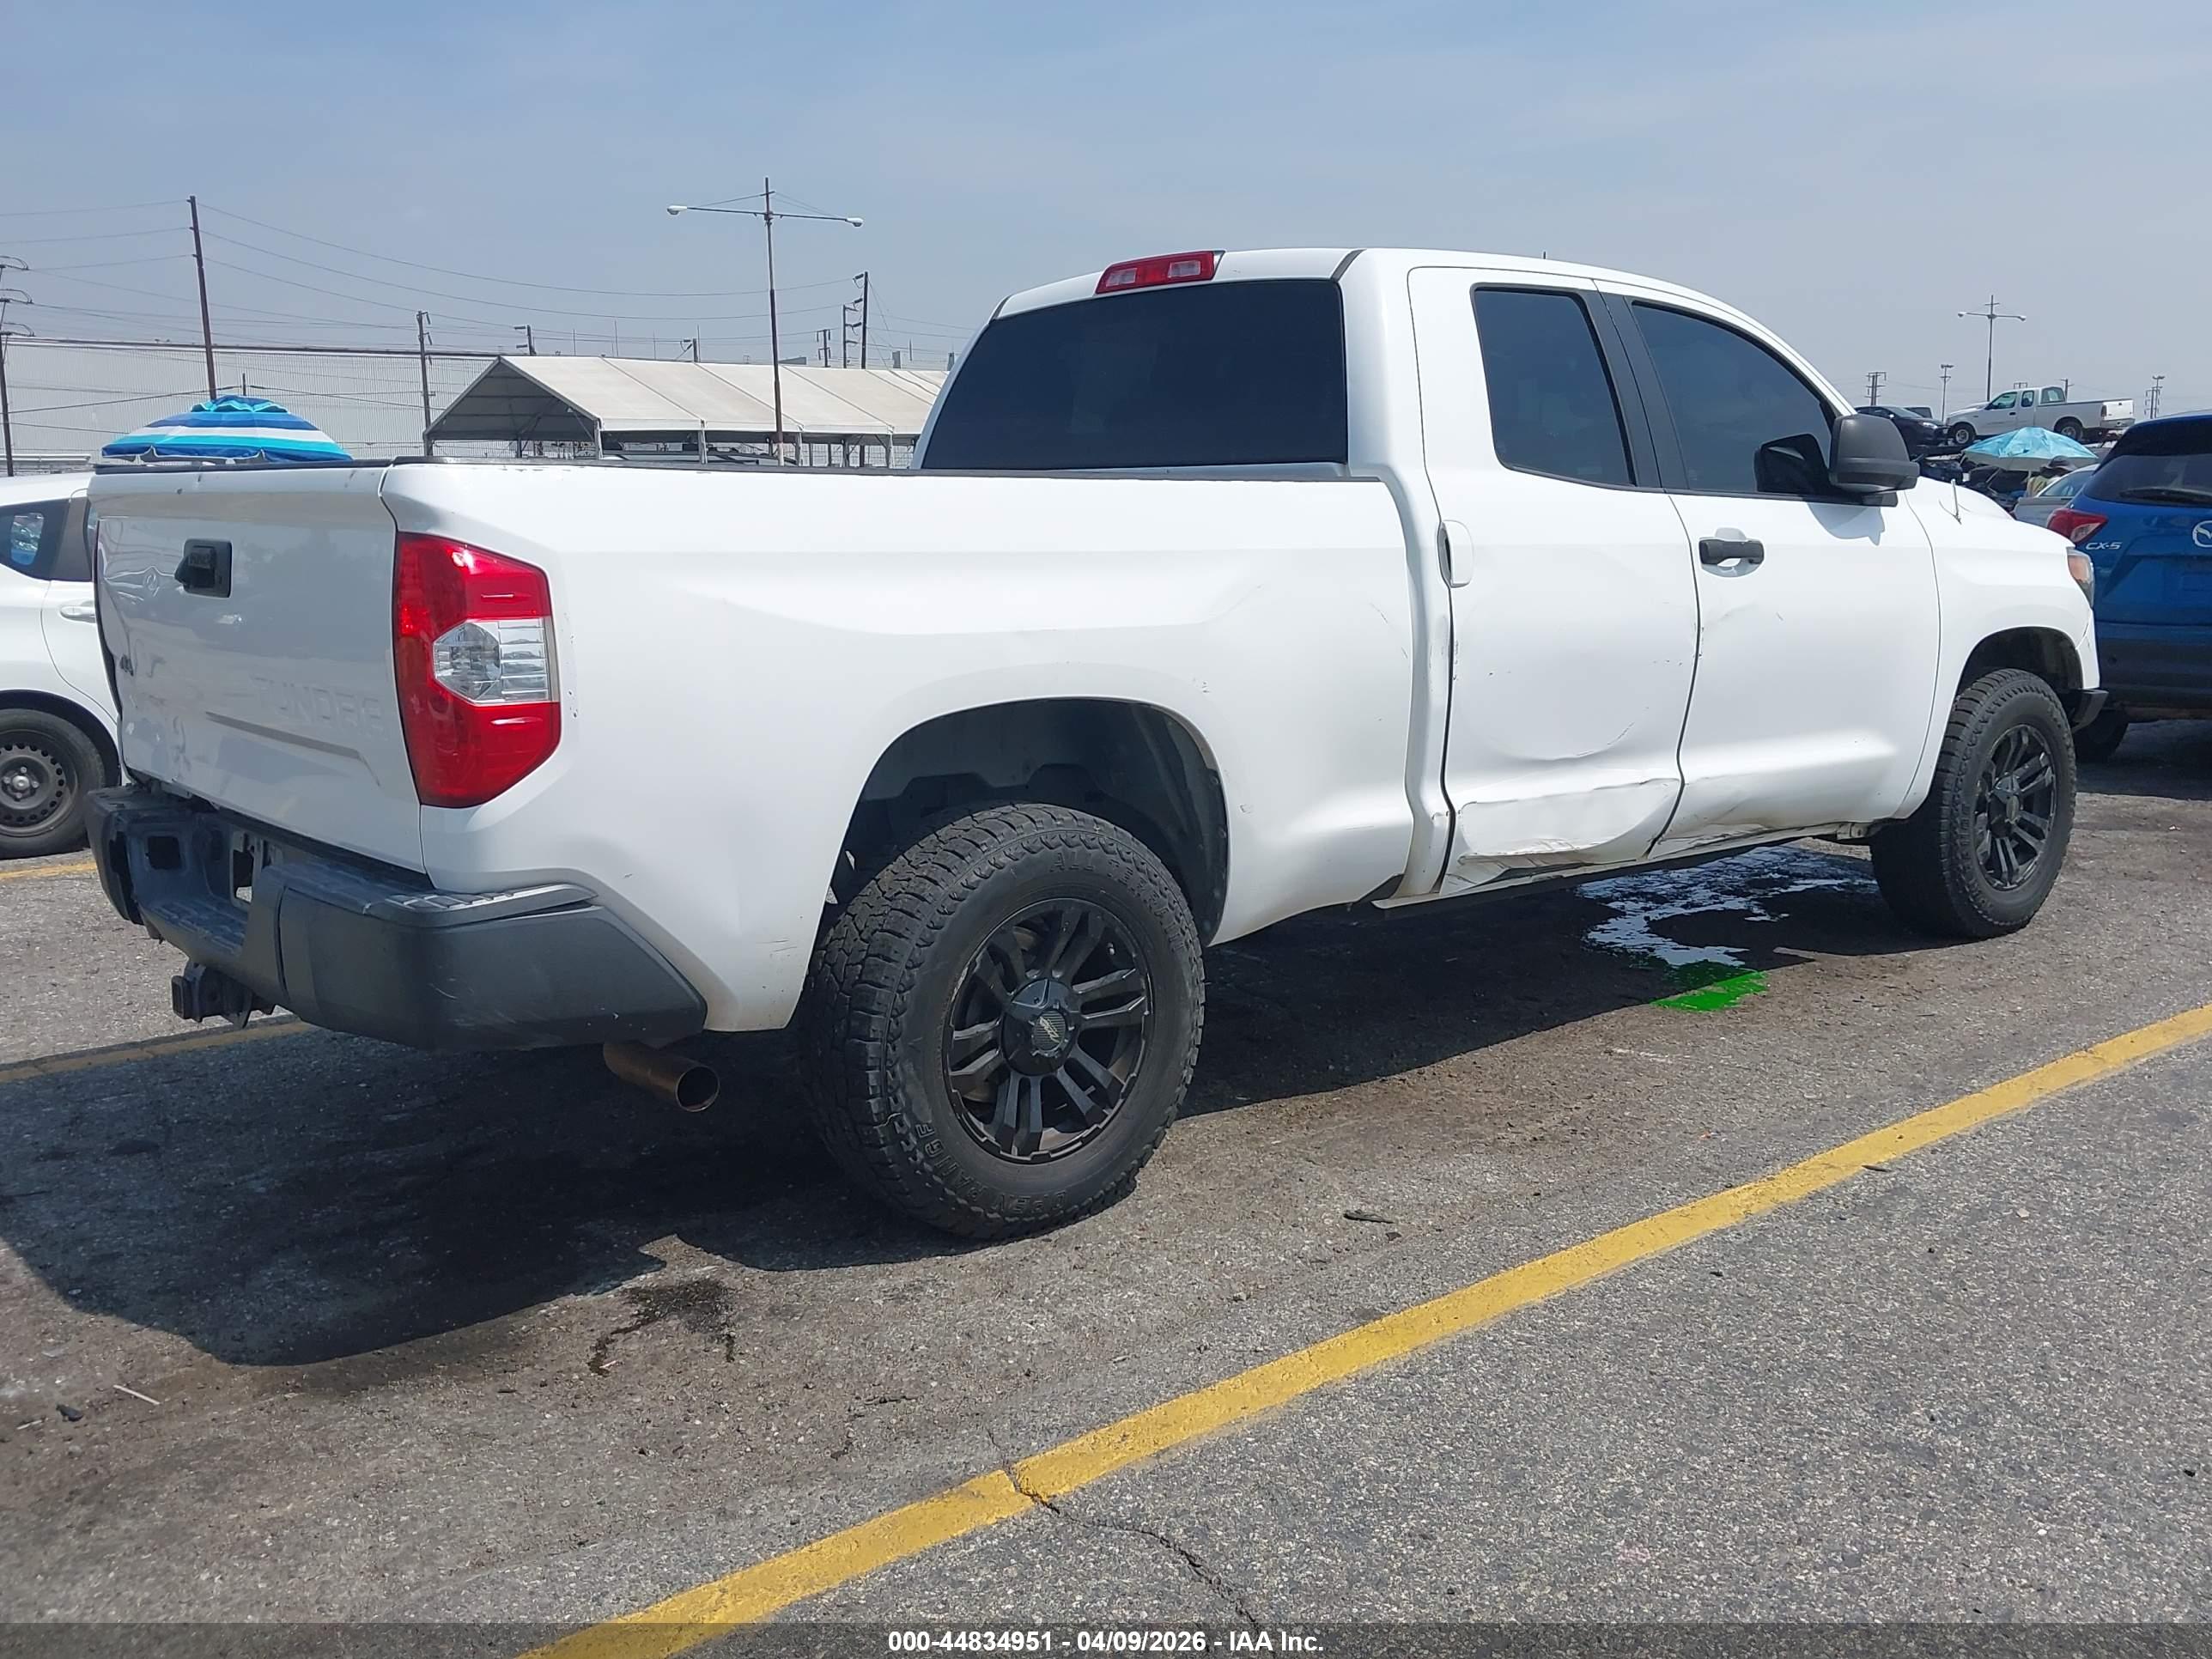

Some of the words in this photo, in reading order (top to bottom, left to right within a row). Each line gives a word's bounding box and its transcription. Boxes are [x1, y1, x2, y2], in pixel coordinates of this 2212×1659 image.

[1049, 852, 1096, 872] ALL
[1106, 858, 1185, 954] TERRAIN
[914, 1122, 989, 1202] RANGE
[990, 1189, 1067, 1214] OPEN
